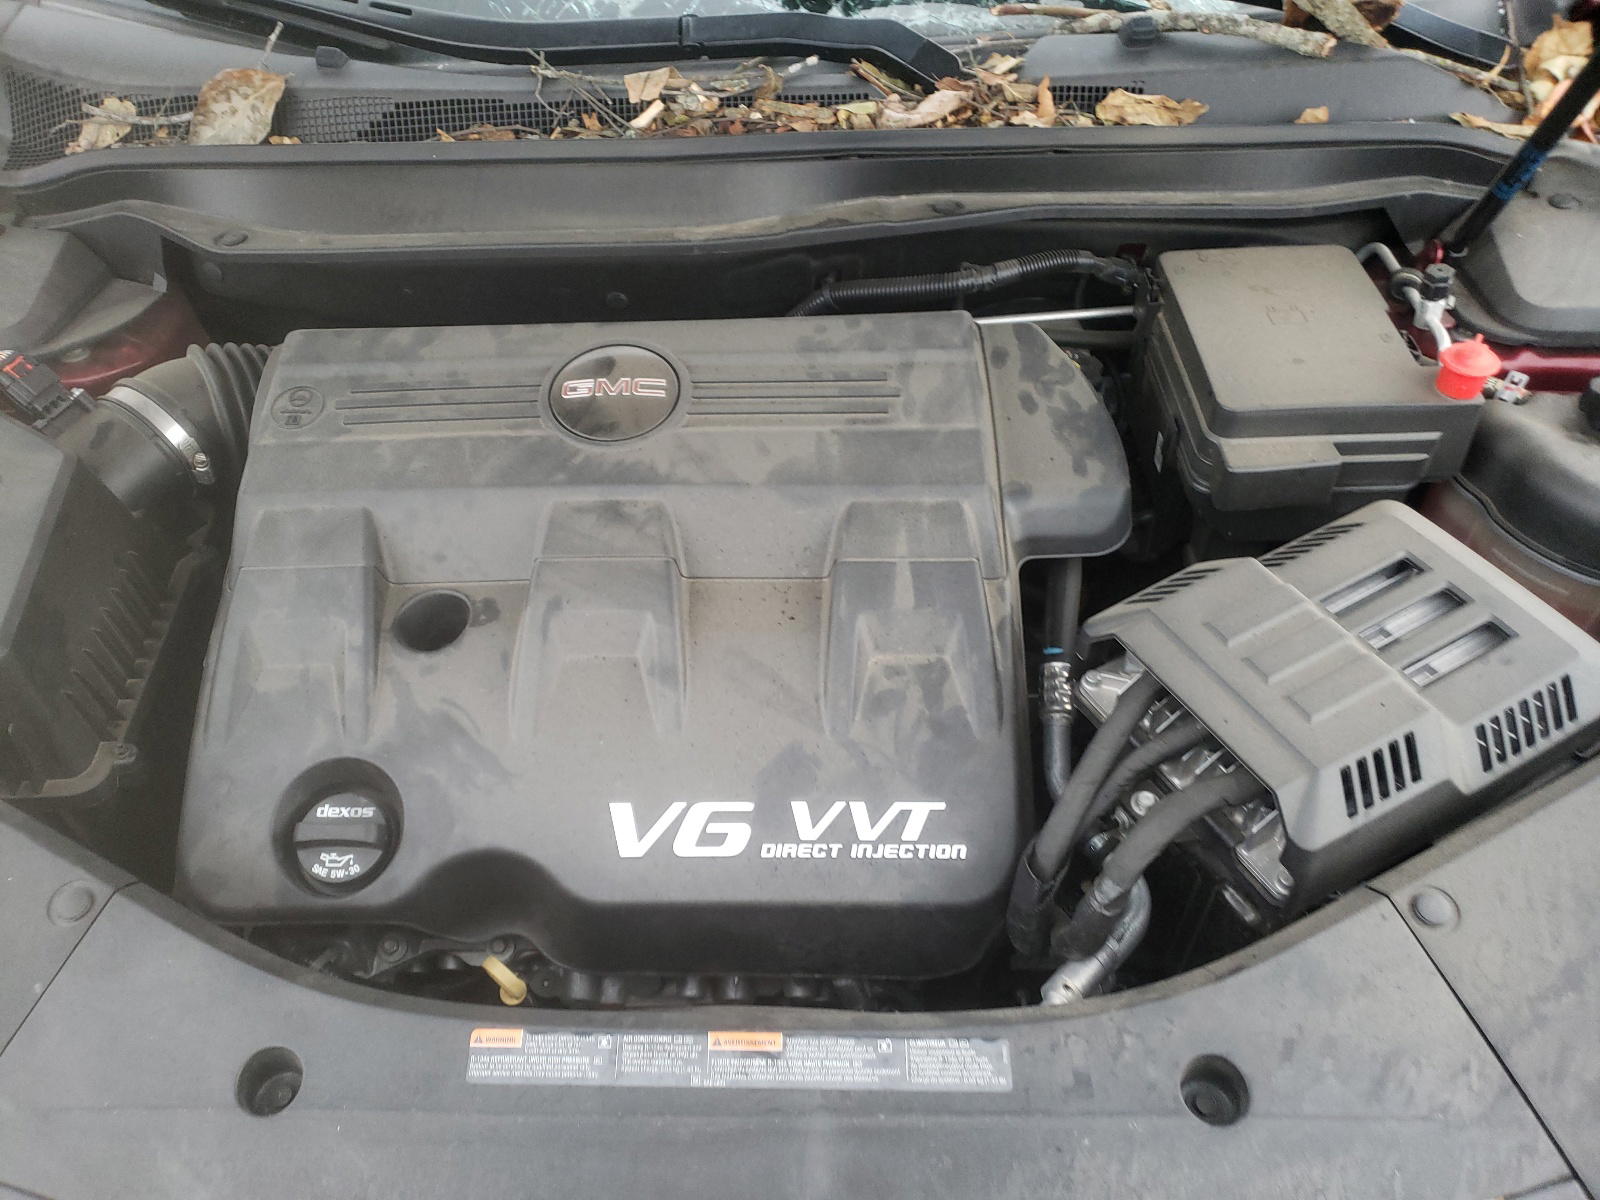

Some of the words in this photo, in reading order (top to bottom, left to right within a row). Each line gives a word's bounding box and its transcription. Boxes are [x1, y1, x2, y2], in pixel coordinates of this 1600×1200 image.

[561, 377, 667, 398] GMC
[316, 803, 377, 818] dexos
[608, 801, 755, 858] V6
[790, 800, 946, 842] VVT
[760, 842, 843, 859] DIRECT
[850, 842, 968, 860] INJECTION
[311, 863, 329, 878] SAE
[330, 863, 361, 879] 5W-30
